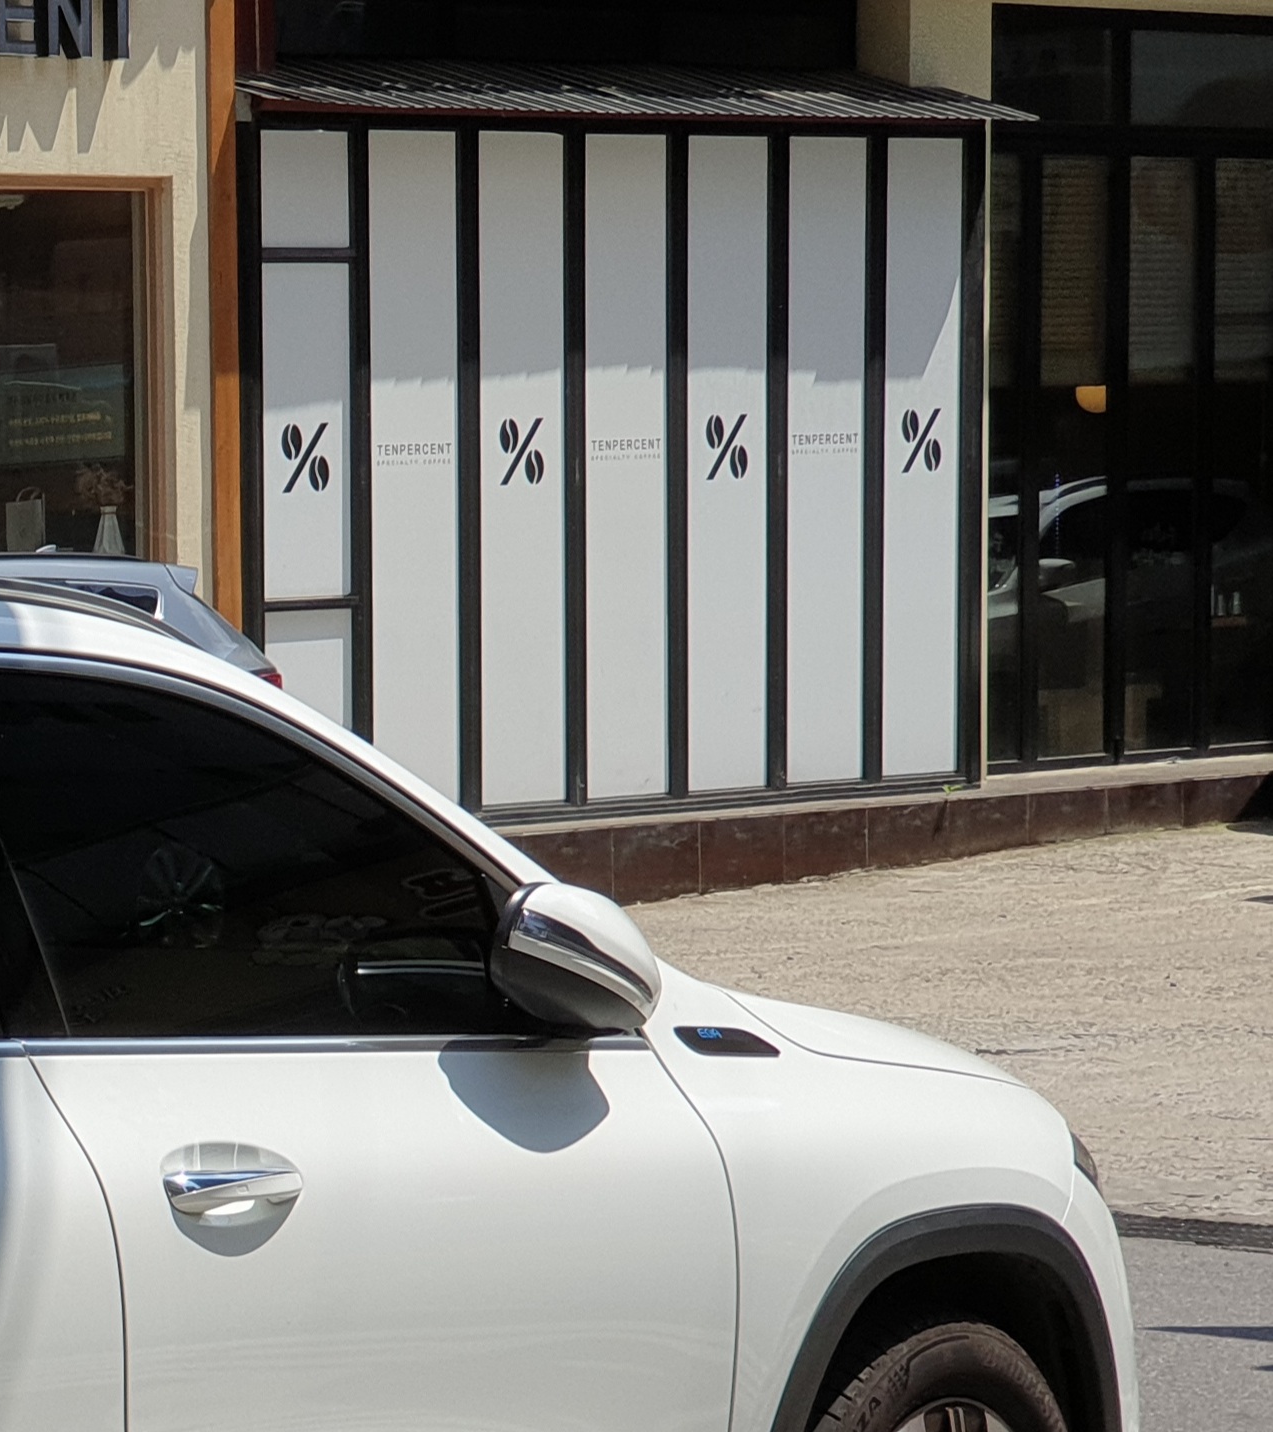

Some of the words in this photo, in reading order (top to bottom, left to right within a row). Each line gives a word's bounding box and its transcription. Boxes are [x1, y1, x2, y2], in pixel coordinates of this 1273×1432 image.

[591, 438, 661, 451] TENPERCENT
[792, 432, 858, 446] TENPERCENT
[376, 442, 452, 456] TENPERCENT
